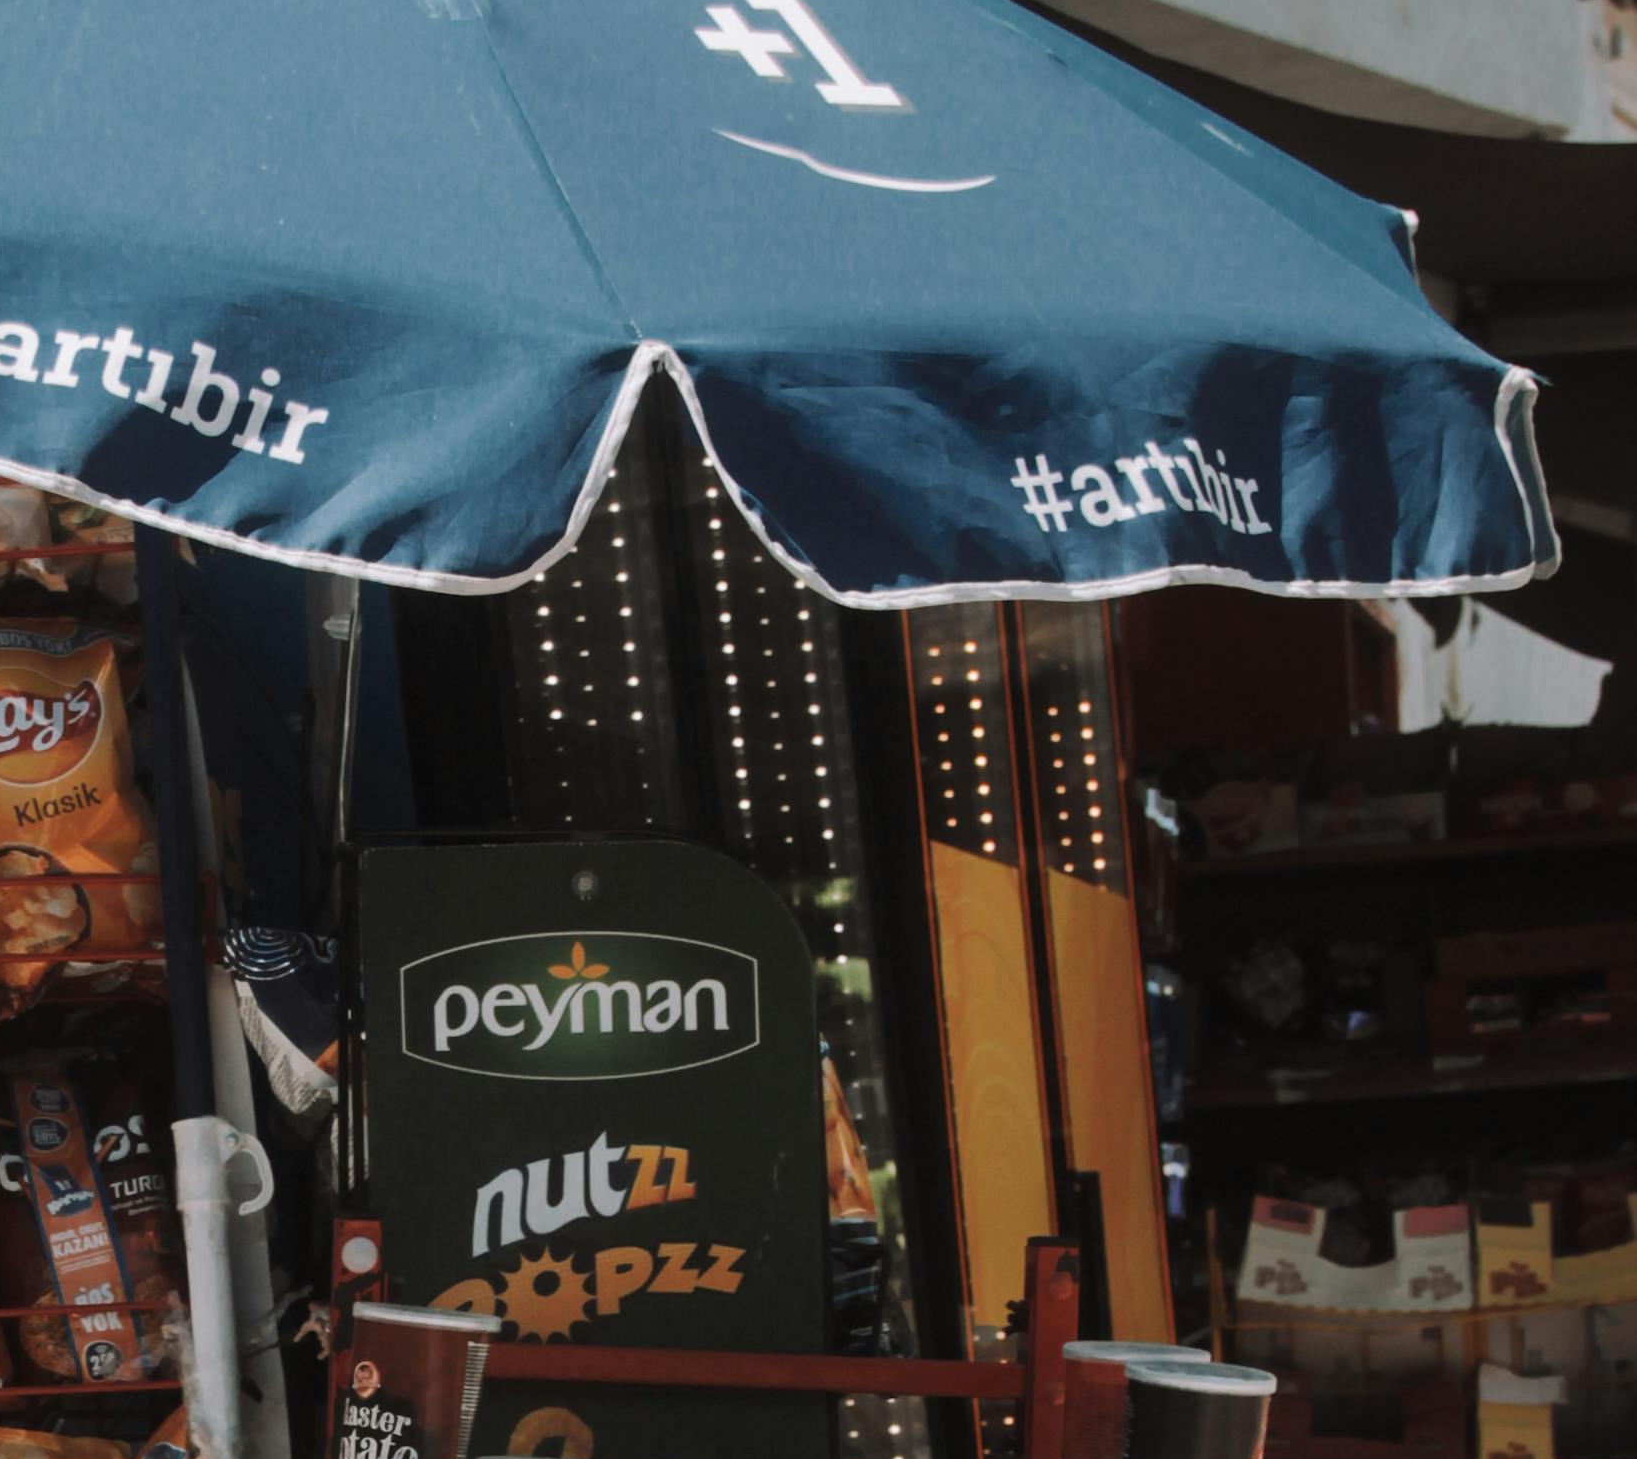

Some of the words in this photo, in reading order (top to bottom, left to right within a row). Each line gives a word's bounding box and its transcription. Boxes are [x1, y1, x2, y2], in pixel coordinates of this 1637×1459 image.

[14, 784, 102, 828] Klasik
[434, 979, 729, 1051] peyman
[472, 1131, 696, 1258] nutzz
